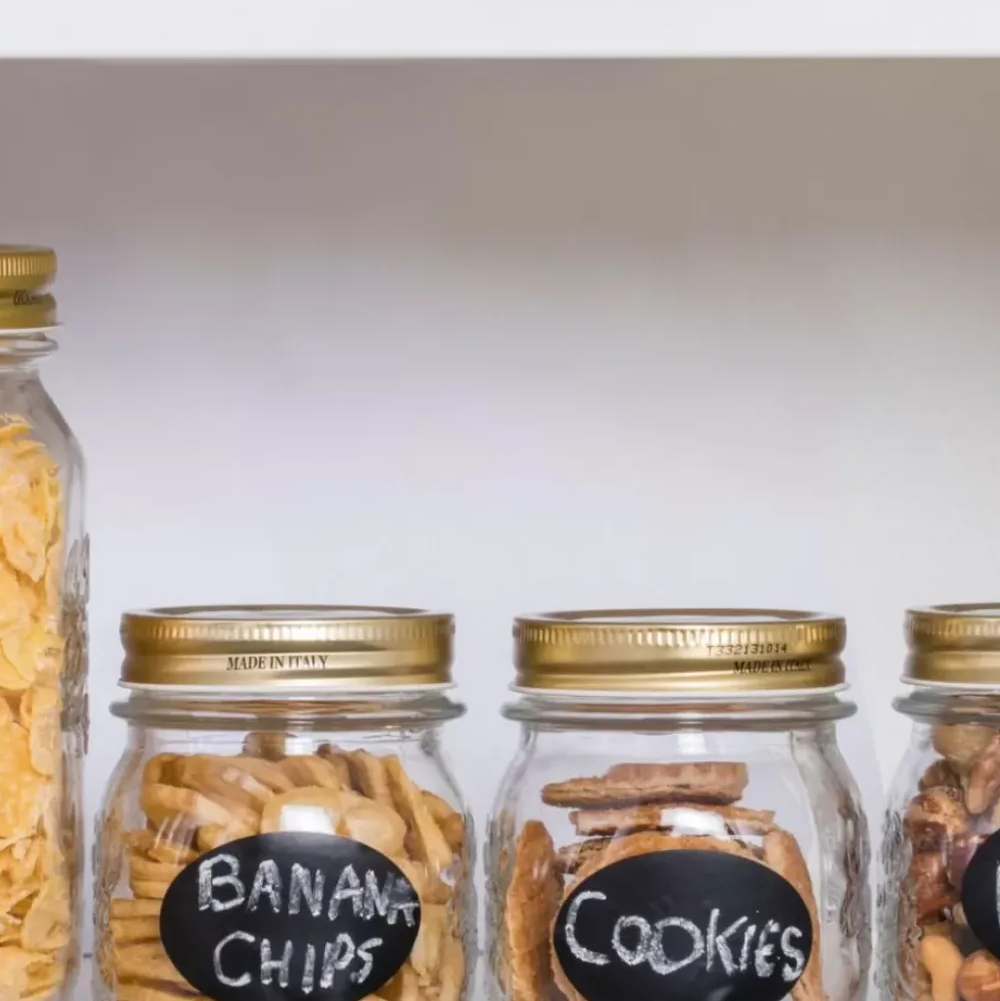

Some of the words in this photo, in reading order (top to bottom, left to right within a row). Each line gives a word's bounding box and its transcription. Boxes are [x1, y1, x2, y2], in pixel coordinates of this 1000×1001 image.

[226, 655, 267, 671] MADE
[269, 655, 285, 670] IN
[288, 654, 329, 669] ITALY
[733, 660, 769, 675] MADE
[770, 659, 783, 672] IN
[198, 854, 421, 928] BANANA
[213, 930, 383, 994] CHIPS
[565, 890, 805, 982] COOKIES
